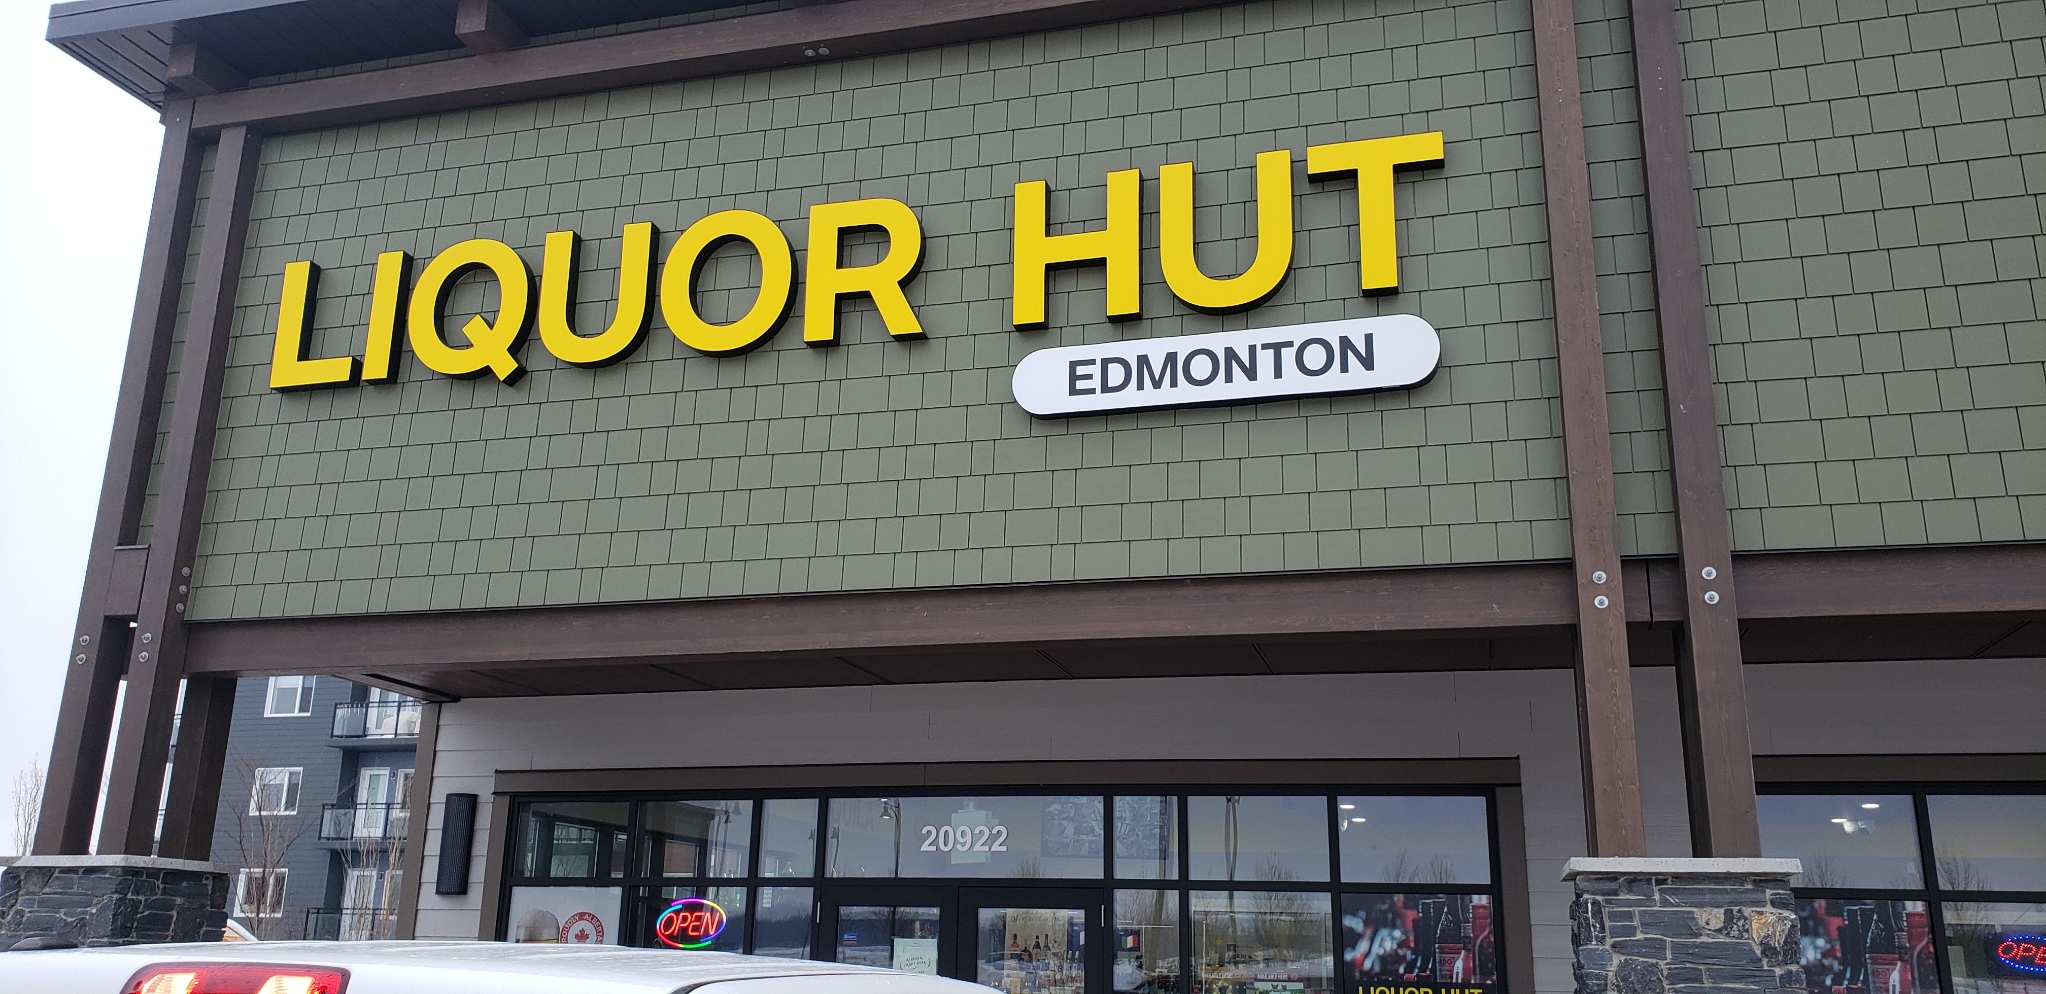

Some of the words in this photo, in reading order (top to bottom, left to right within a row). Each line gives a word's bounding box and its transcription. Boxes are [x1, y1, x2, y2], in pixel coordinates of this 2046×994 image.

[269, 197, 927, 391] LIQUOR
[1012, 130, 1445, 331] HUT
[1068, 332, 1375, 397] EDMONTON
[920, 825, 1008, 852] 20922
[561, 914, 580, 943] ROUDLY
[583, 913, 603, 944] ALBERTA
[660, 911, 720, 937] OPEN
[1997, 941, 2046, 964] OPE
